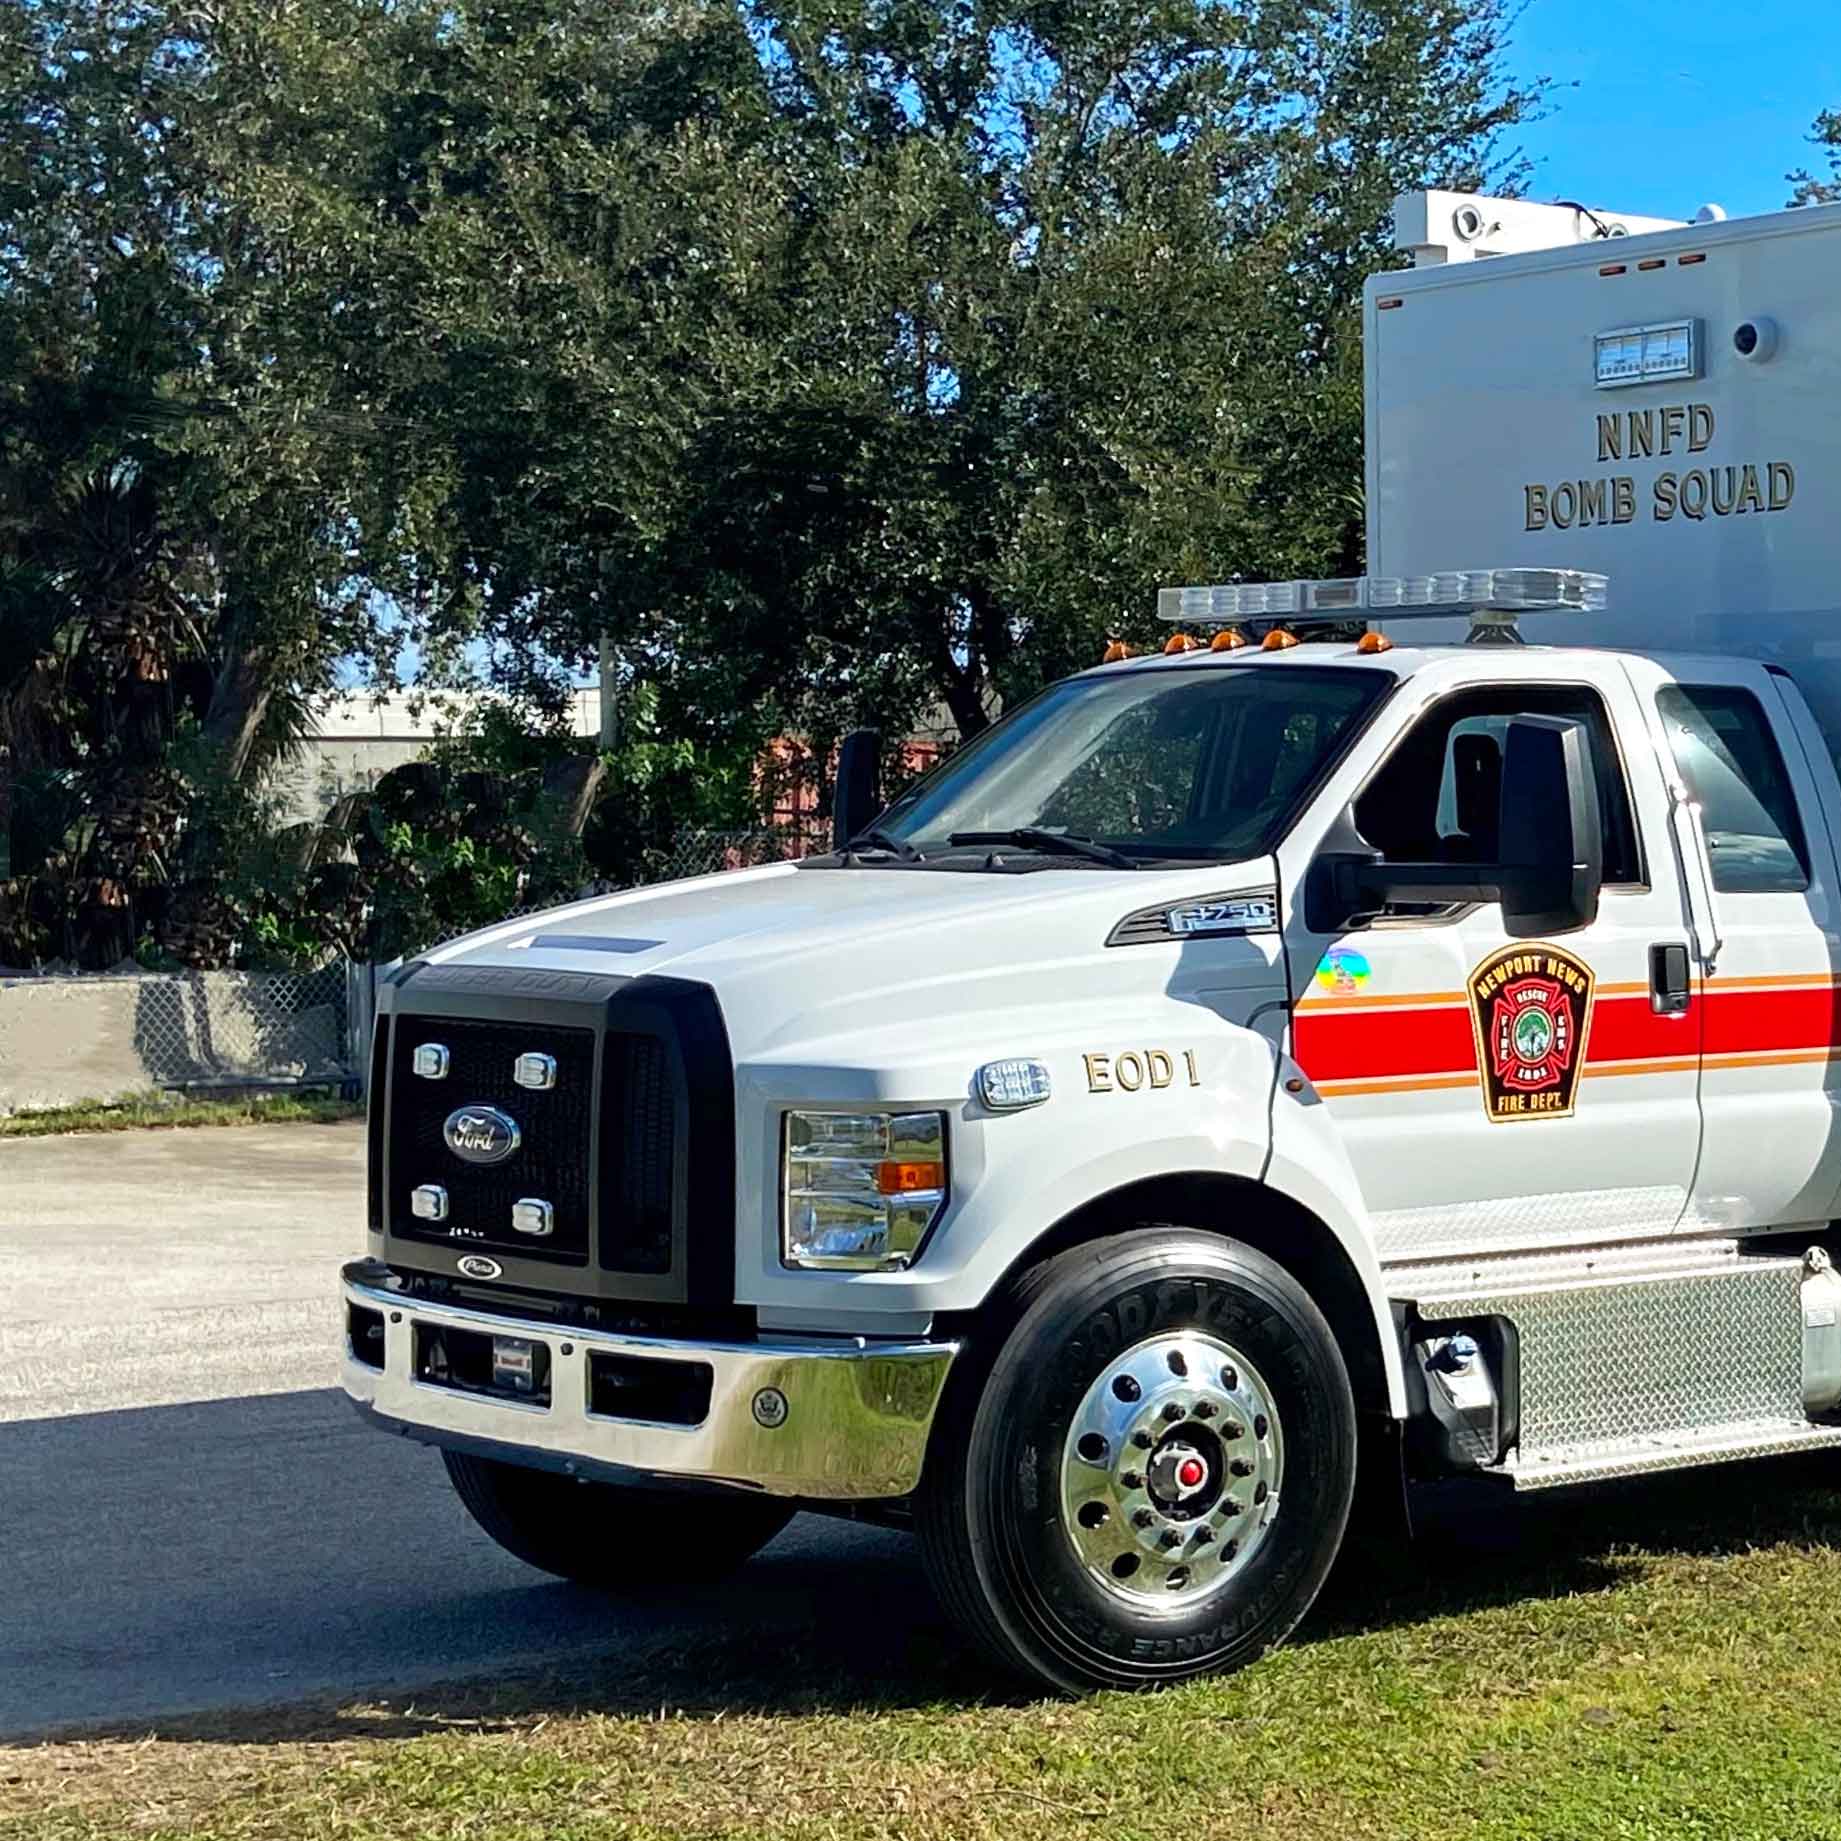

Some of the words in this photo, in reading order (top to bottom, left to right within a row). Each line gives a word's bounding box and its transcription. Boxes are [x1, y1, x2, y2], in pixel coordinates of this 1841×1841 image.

[1597, 403, 1715, 462] NNFD
[1524, 476, 1636, 531] BOMB
[1654, 461, 1794, 522] SQUAD
[1477, 955, 1542, 999] NEWPORT
[1547, 958, 1586, 994] NEWS
[1516, 989, 1549, 1003] RESCUE
[1501, 1015, 1509, 1061] FIRE
[1557, 1015, 1566, 1050] EMS
[1082, 1049, 1174, 1093] EOD
[1498, 1093, 1525, 1112] FIRE
[1530, 1091, 1562, 1110] DEPT.
[453, 1114, 496, 1150] Ford
